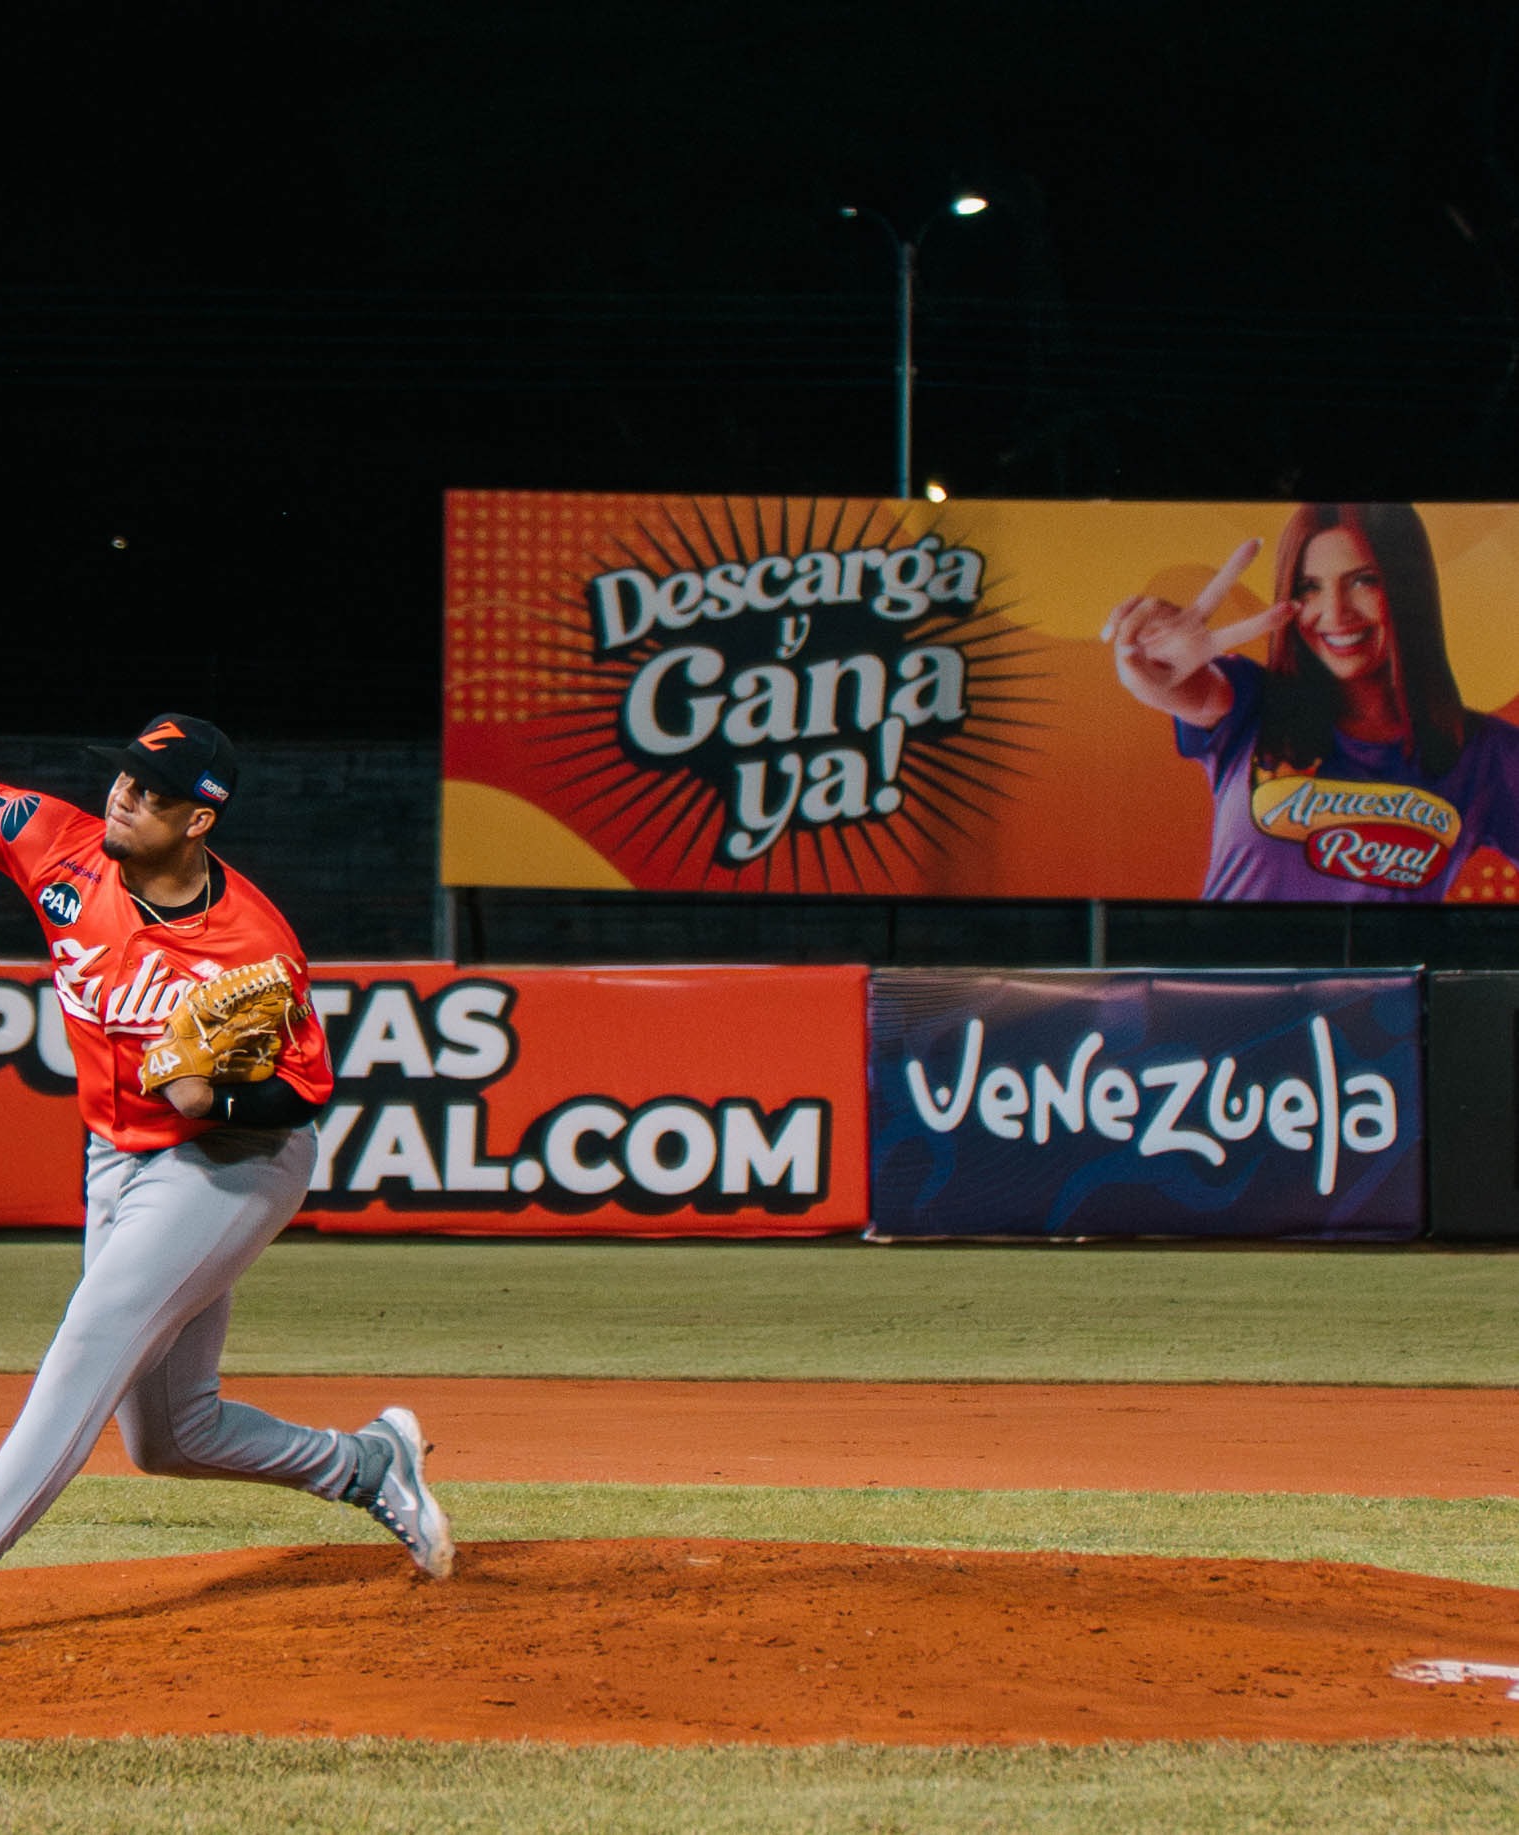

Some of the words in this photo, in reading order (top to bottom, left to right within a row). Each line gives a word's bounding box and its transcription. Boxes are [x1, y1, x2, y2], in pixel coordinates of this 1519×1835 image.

[595, 536, 984, 650] Descarga
[777, 613, 810, 659] y
[625, 645, 966, 756] Gana
[138, 721, 186, 751] Z
[728, 716, 905, 861] ya!
[1262, 781, 1452, 833] Apuestas
[1317, 828, 1439, 877] Royal
[38, 887, 82, 924] PAN
[149, 1050, 181, 1077] 44
